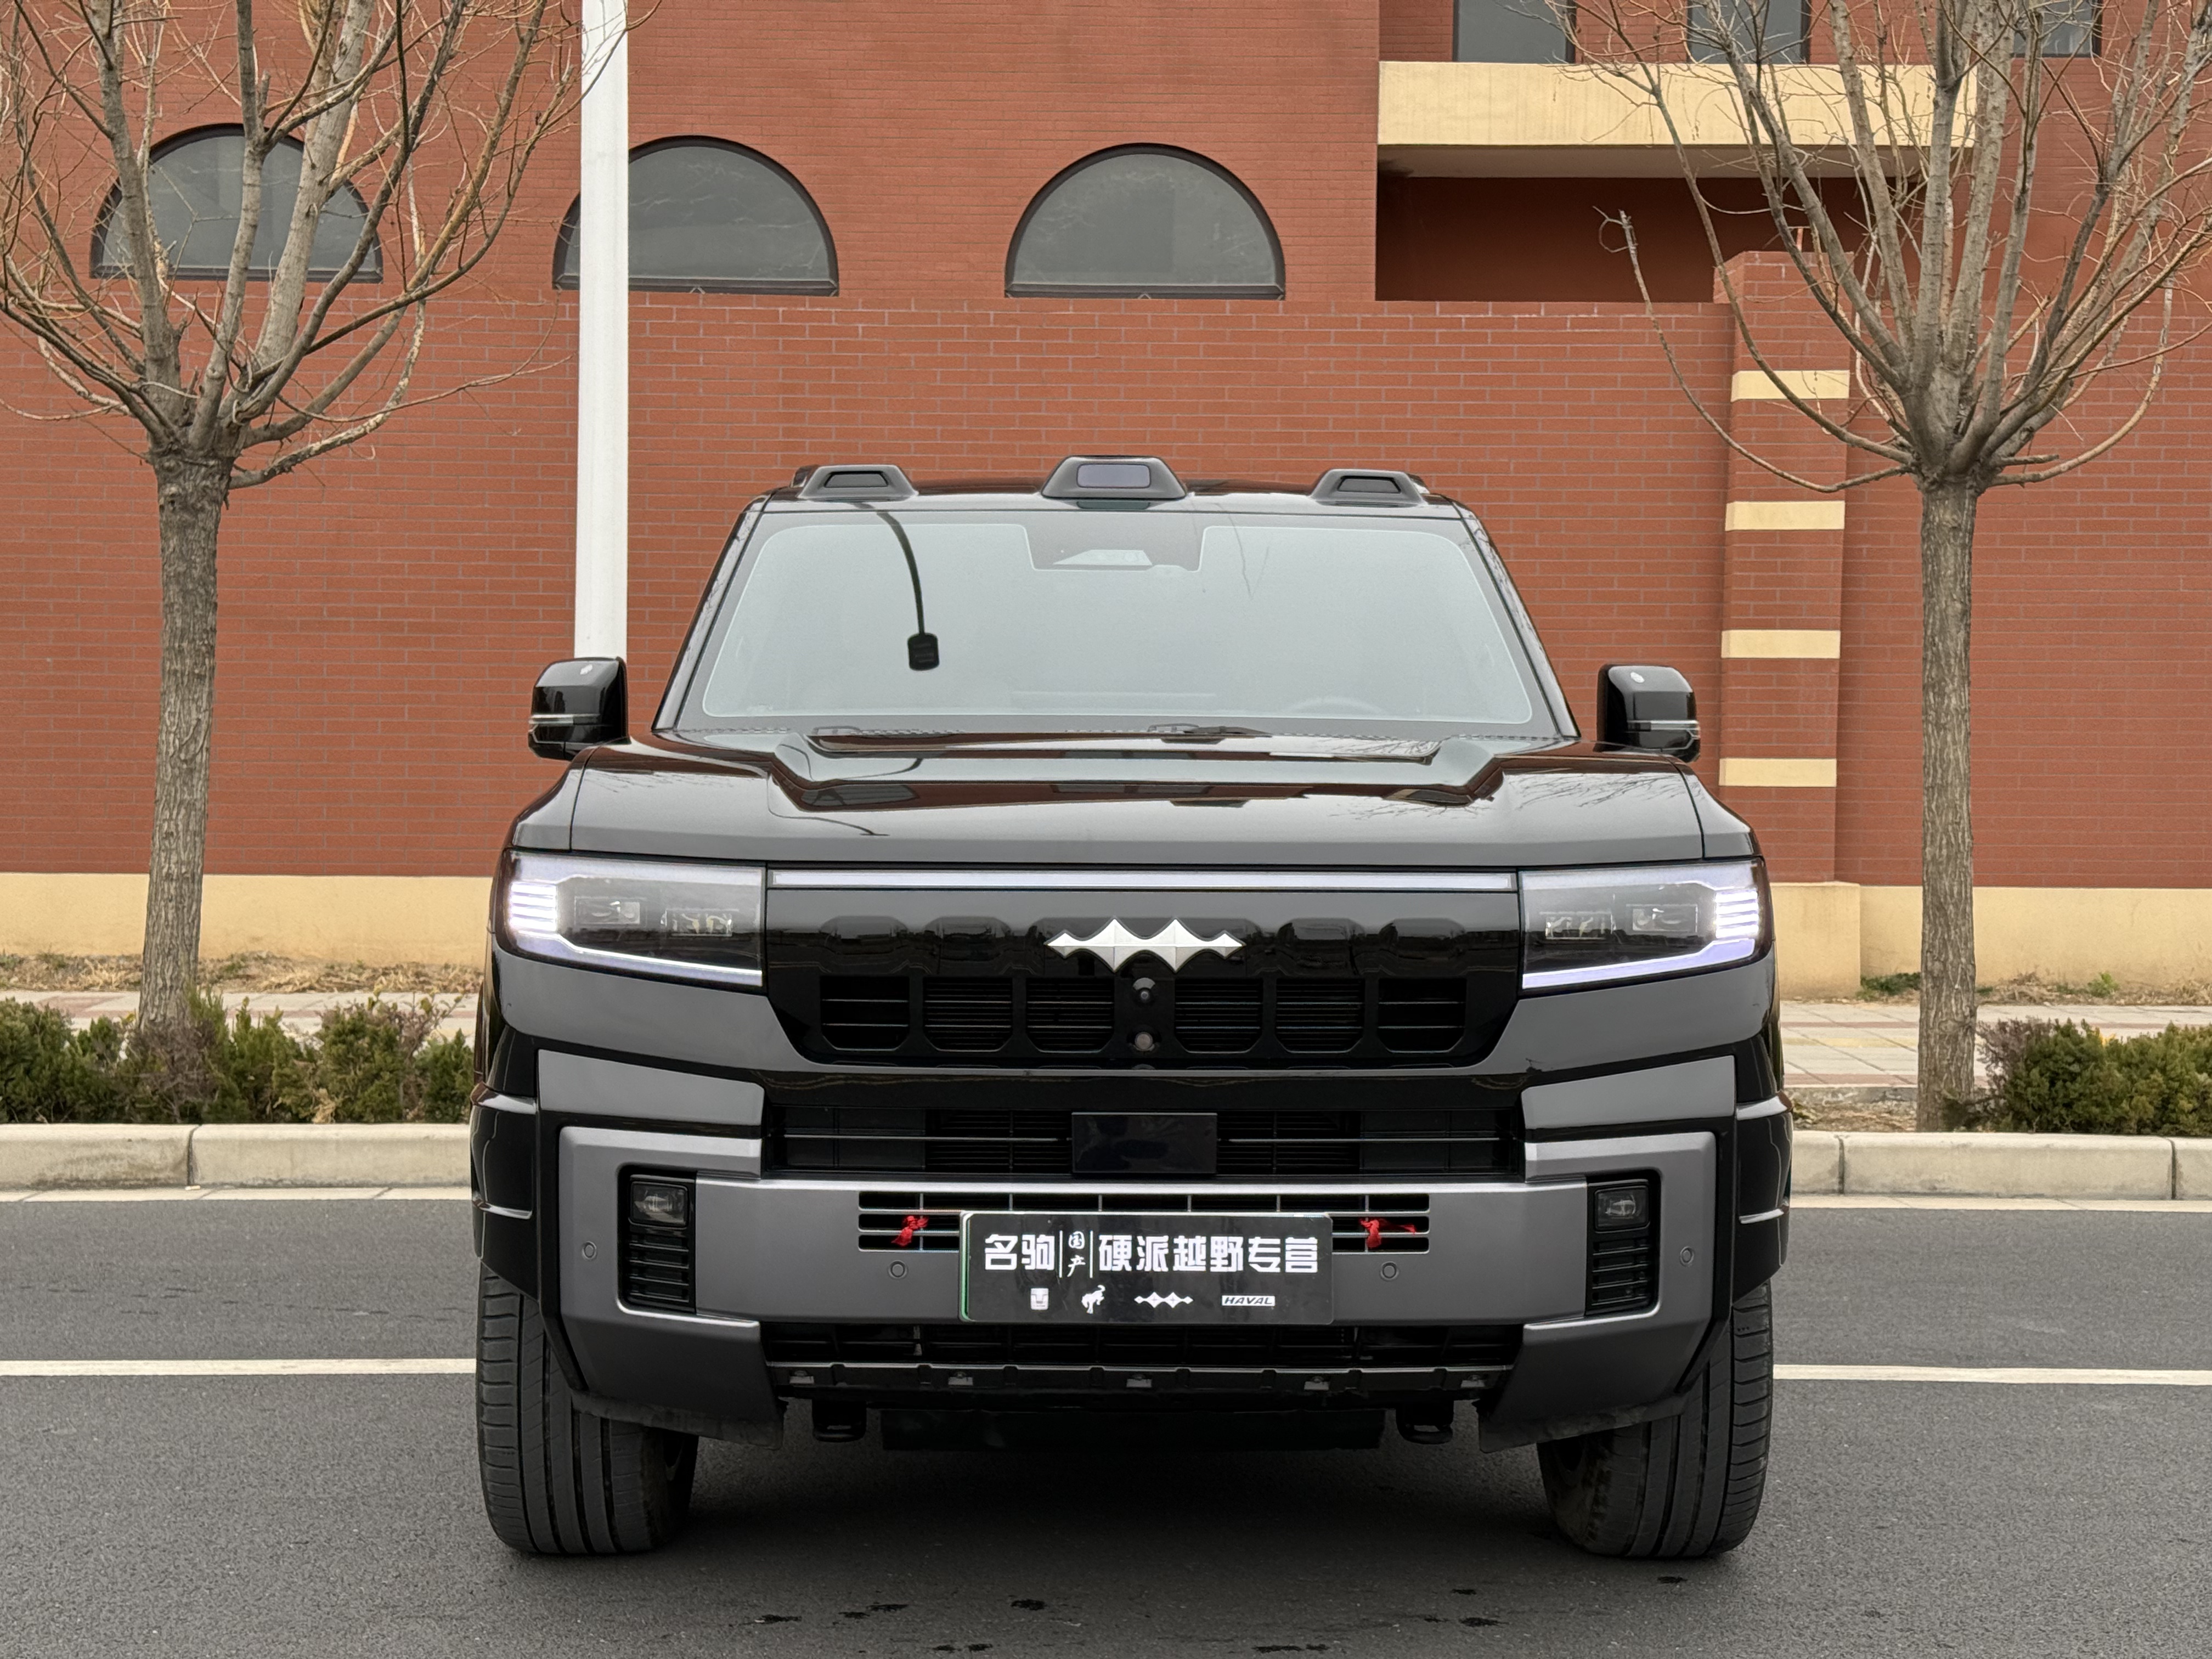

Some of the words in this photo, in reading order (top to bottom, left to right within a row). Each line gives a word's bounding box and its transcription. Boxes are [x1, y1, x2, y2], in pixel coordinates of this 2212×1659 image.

[985, 1234, 1055, 1271] 名驹
[1098, 1234, 1318, 1273] 硬派越野专营
[1223, 1296, 1273, 1306] HAVAL
